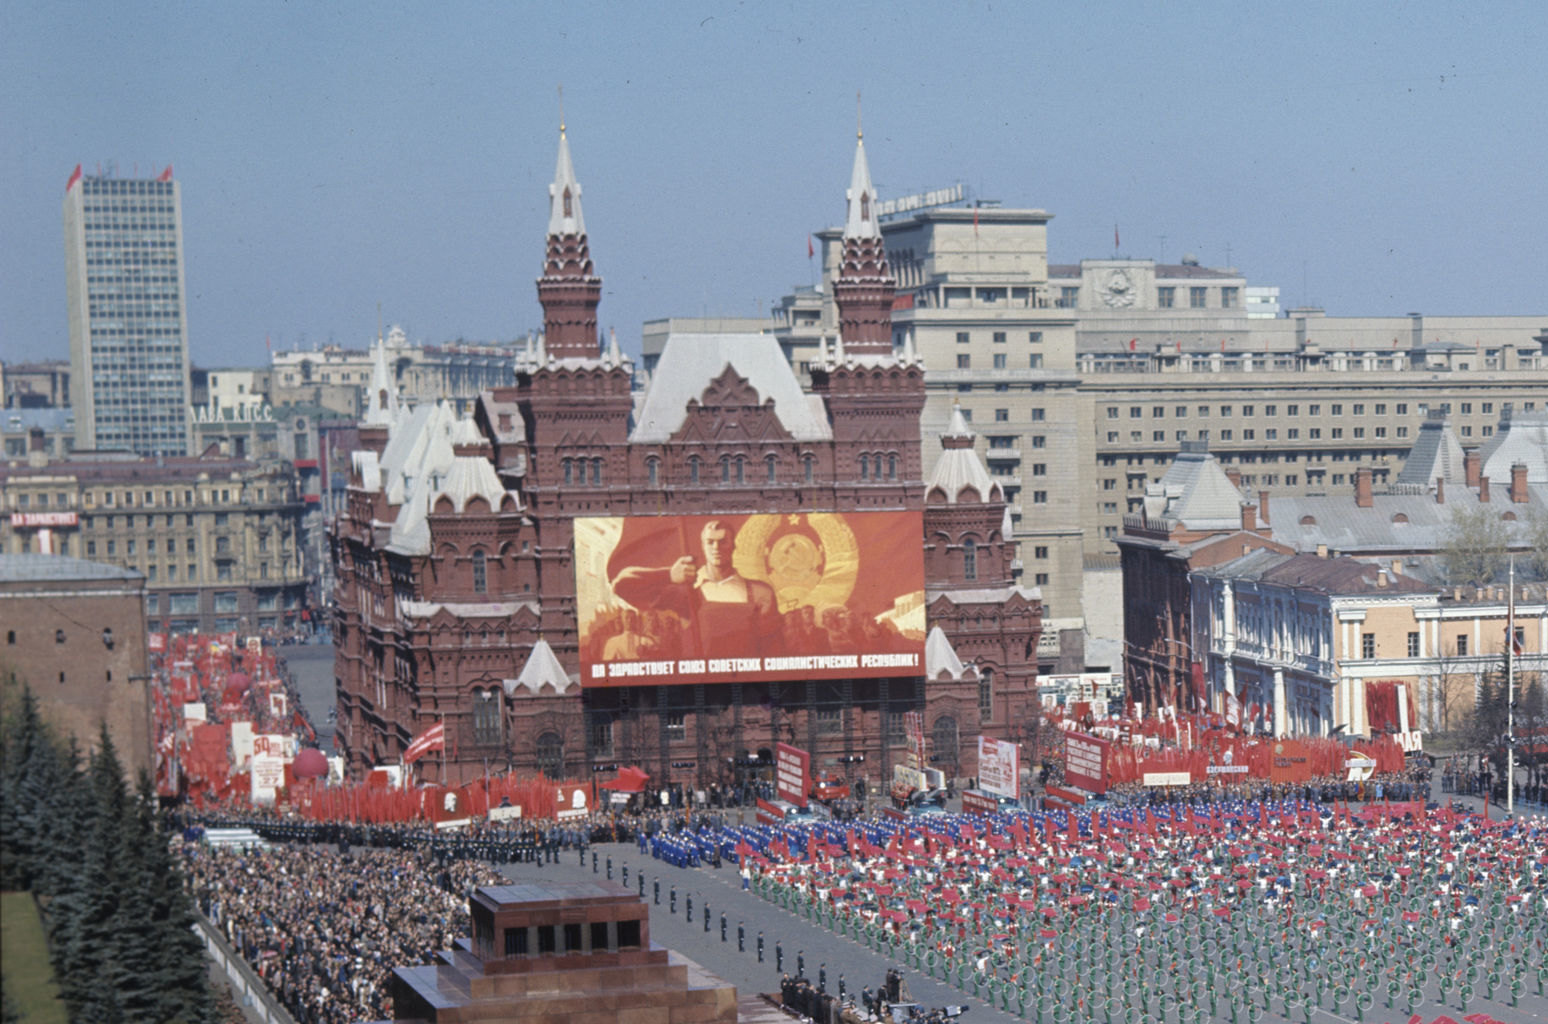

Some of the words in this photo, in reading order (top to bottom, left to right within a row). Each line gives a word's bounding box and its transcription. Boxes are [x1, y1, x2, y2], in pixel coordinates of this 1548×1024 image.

[592, 664, 605, 678] ДА
[608, 661, 675, 677] ЗДРАВСТВУЕТ
[678, 659, 706, 674] СОЮЗ
[708, 658, 761, 673] СОВЕТСКИХ
[764, 655, 859, 671] СОЦИАЛИСТИЧЕСКИХ
[861, 653, 919, 668] РЕСПУБЛИК!
